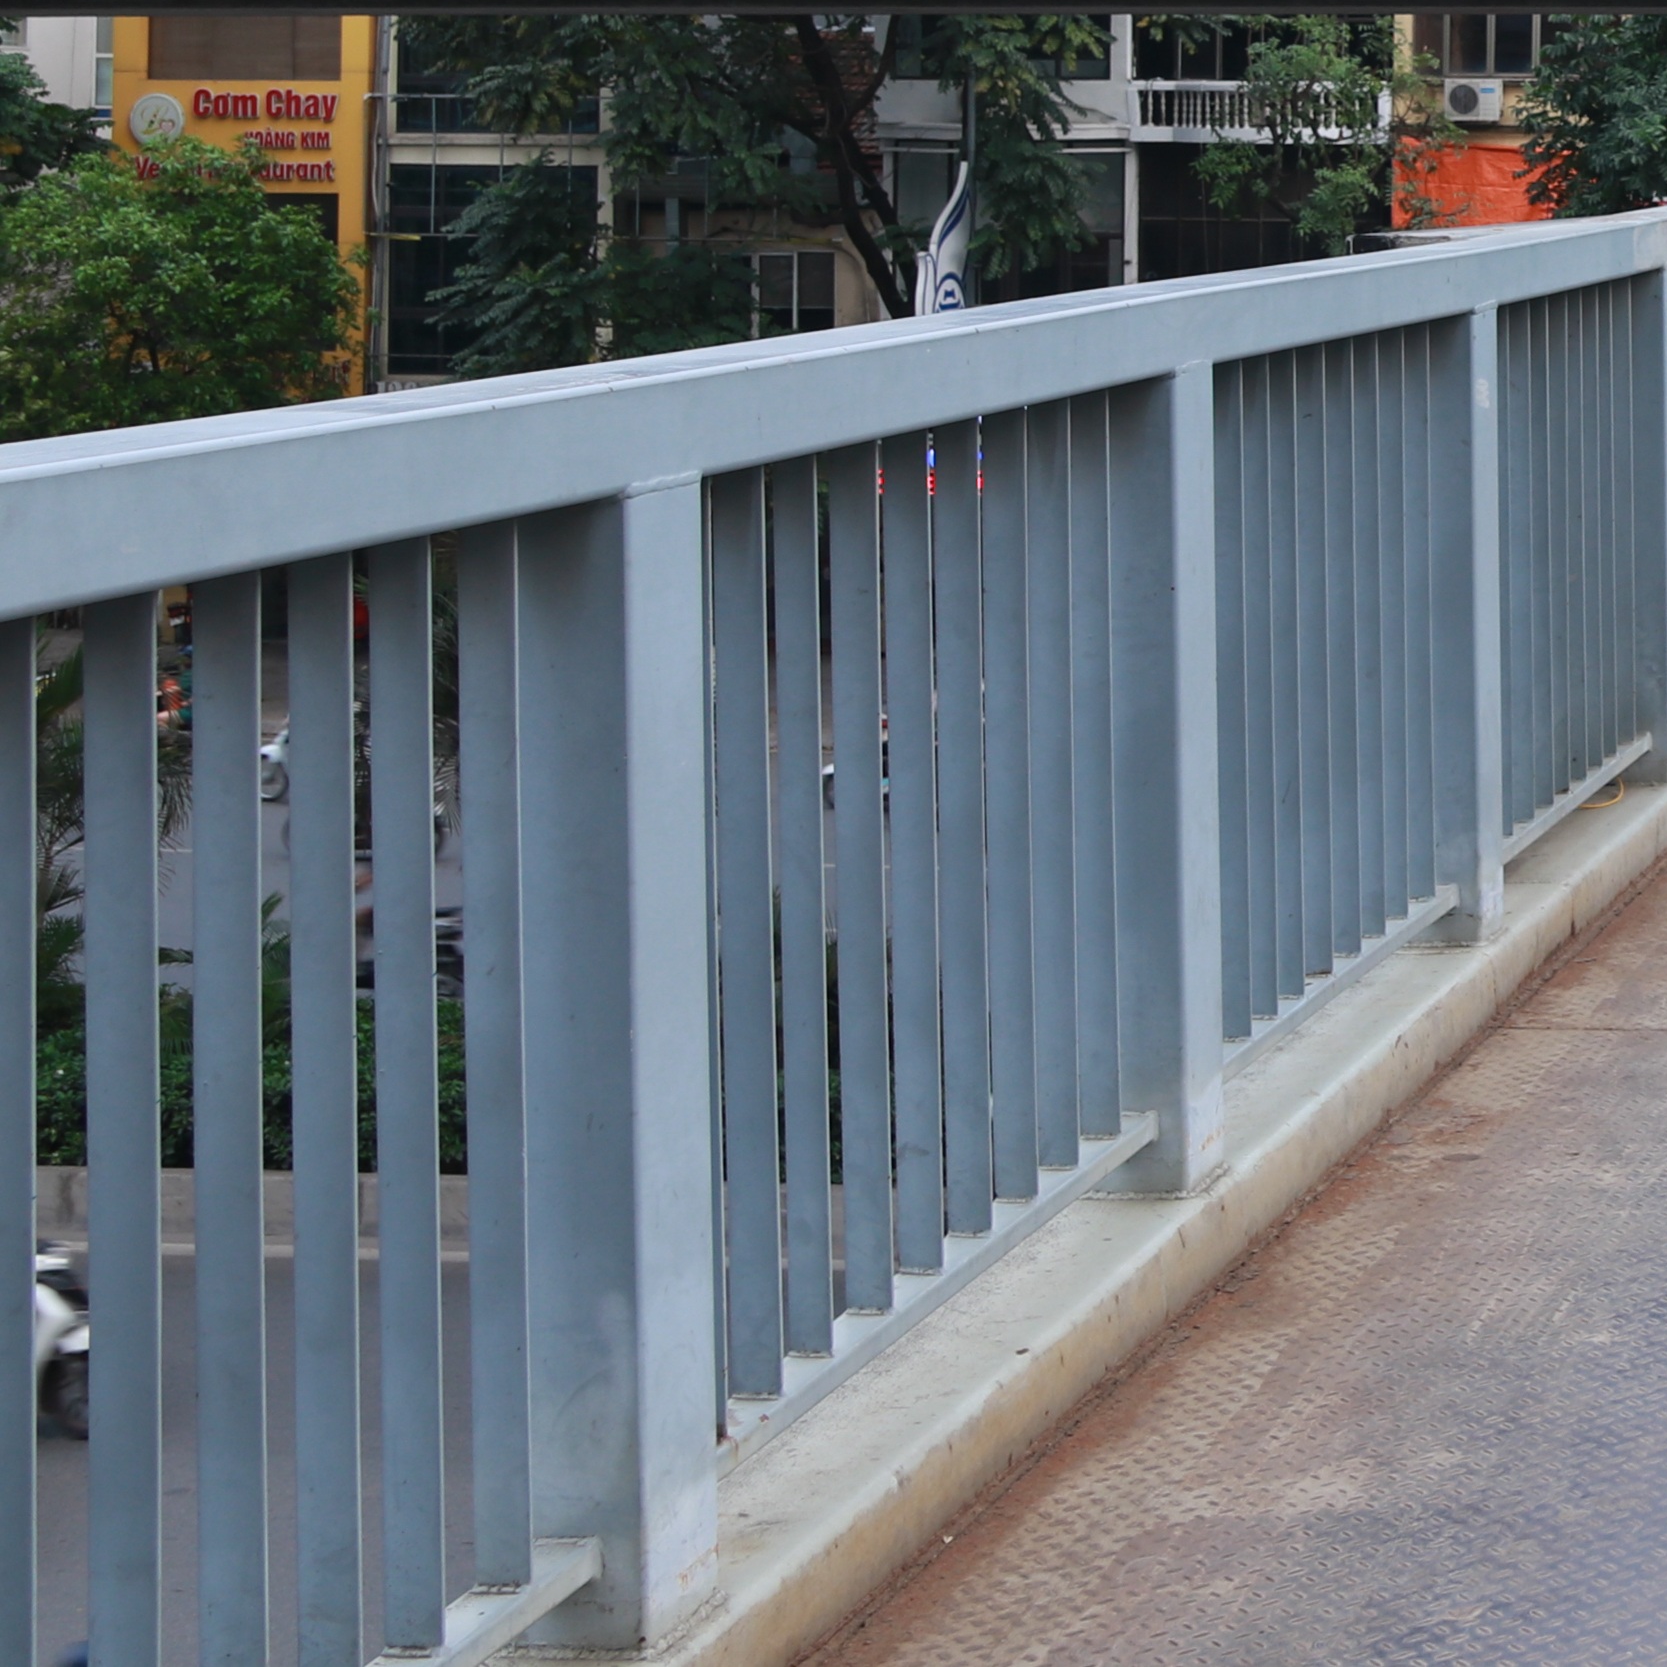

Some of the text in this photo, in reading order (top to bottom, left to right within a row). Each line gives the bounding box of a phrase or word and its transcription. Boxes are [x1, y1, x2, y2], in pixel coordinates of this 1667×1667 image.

[193, 88, 338, 122] Cơm Chay
[300, 130, 331, 150] KIM
